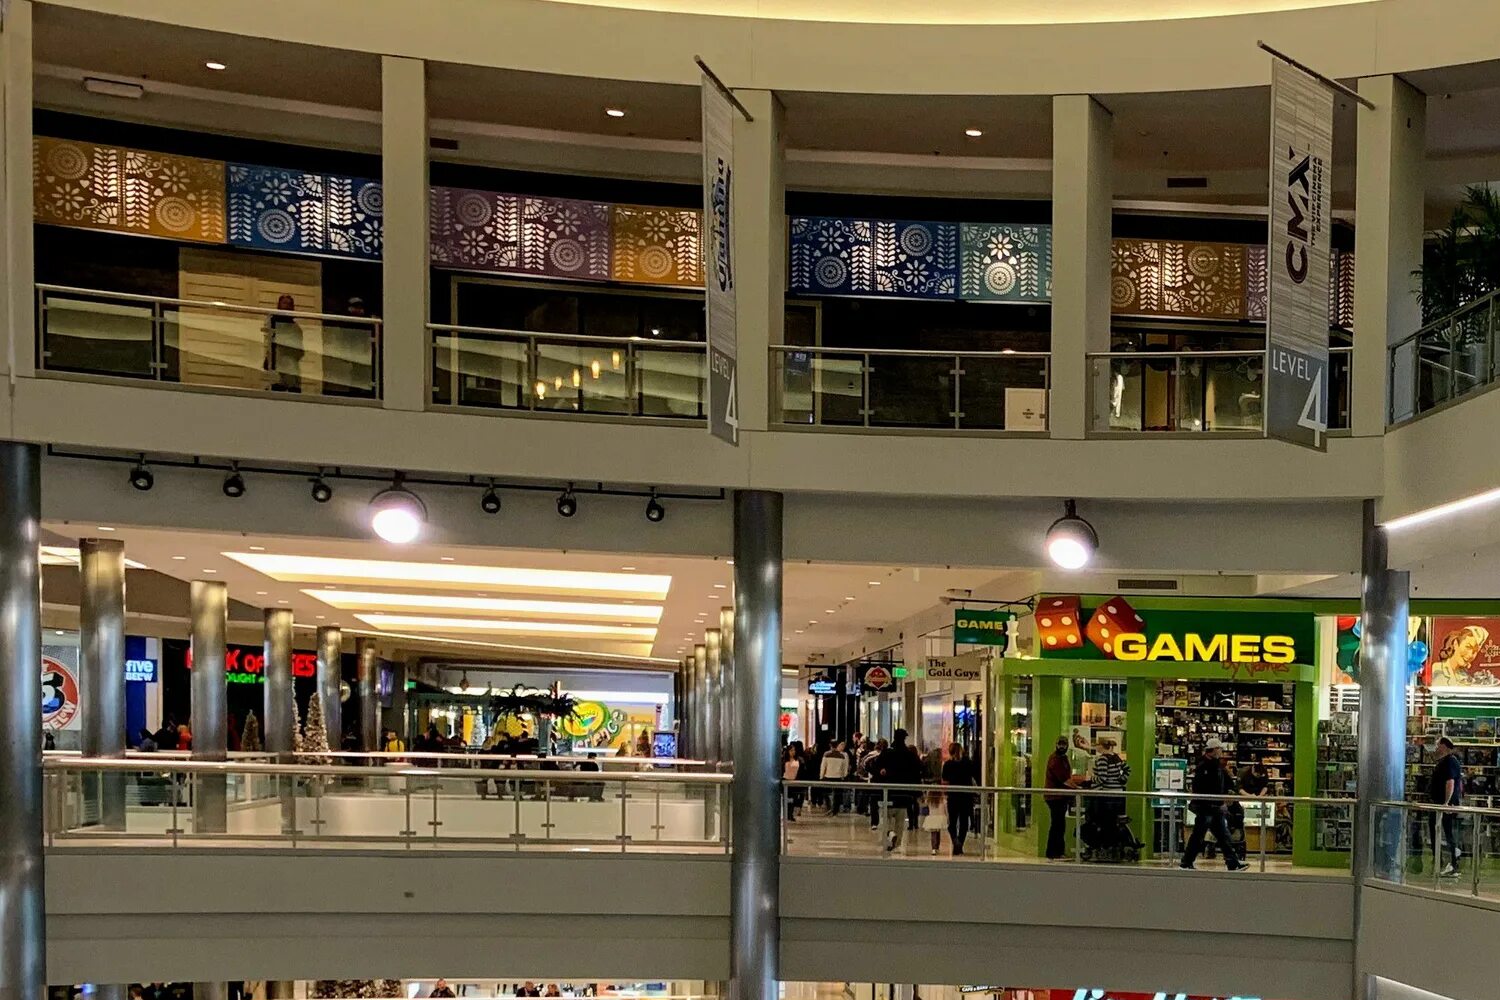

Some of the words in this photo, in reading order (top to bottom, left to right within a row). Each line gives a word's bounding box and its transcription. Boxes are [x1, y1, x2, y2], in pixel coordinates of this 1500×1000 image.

[1285, 146, 1311, 284] CMX
[711, 353, 730, 380] LEVEL
[1272, 349, 1311, 381] LEVEL
[725, 366, 739, 442] 4
[1297, 367, 1327, 448] 4
[957, 619, 1004, 630] GAME
[928, 658, 946, 668] The
[1113, 633, 1296, 664] GAMES
[125, 660, 154, 673] five
[928, 668, 952, 678] Gold
[954, 668, 980, 681] Guys
